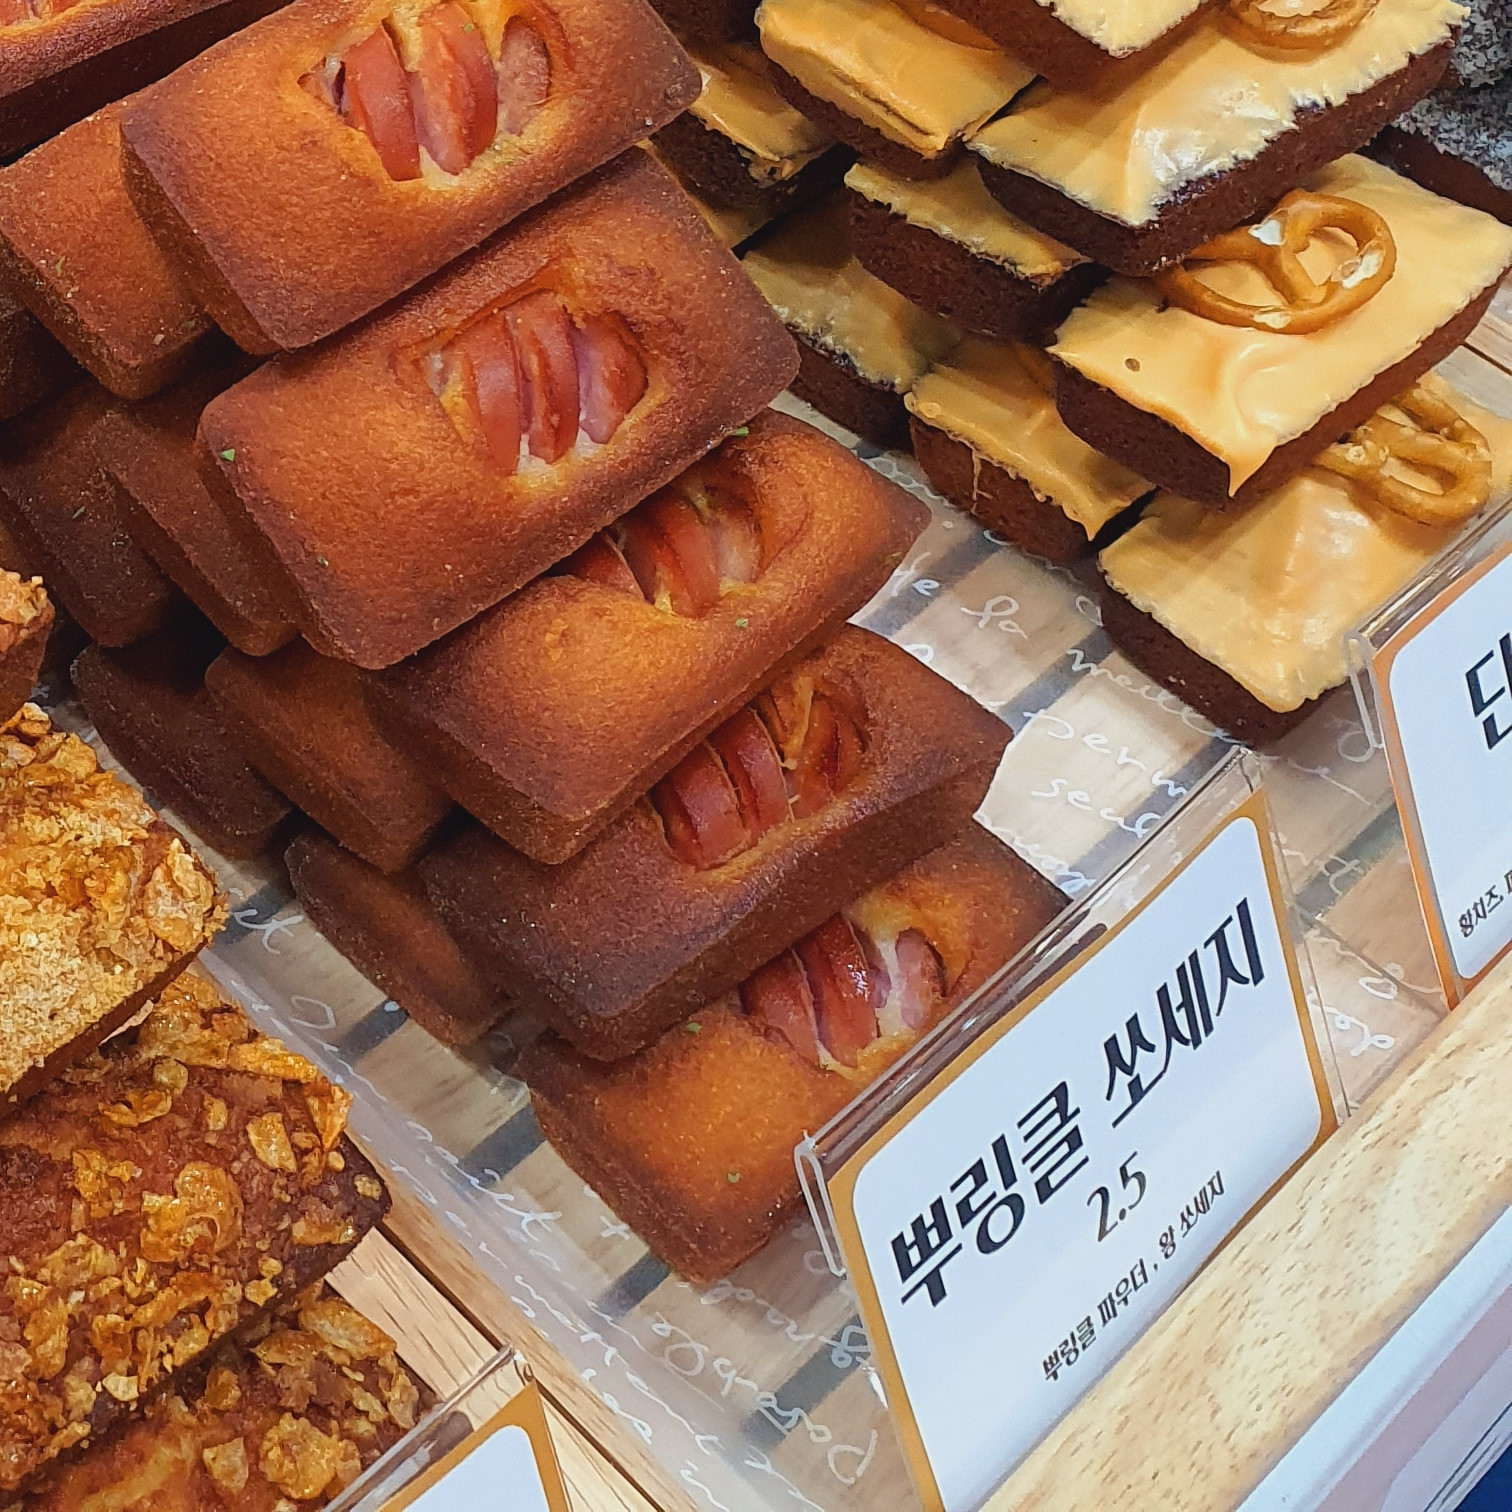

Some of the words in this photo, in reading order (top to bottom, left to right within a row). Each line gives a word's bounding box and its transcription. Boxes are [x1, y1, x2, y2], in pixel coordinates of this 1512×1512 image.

[889, 1080, 1090, 1308] 뿌링클
[1104, 897, 1266, 1130] 쏘세지
[1086, 1150, 1147, 1243] 2.5
[1042, 1315, 1097, 1381] 뿌링클
[1159, 1224, 1177, 1260] 왕
[1180, 1170, 1225, 1238] 쏘세지
